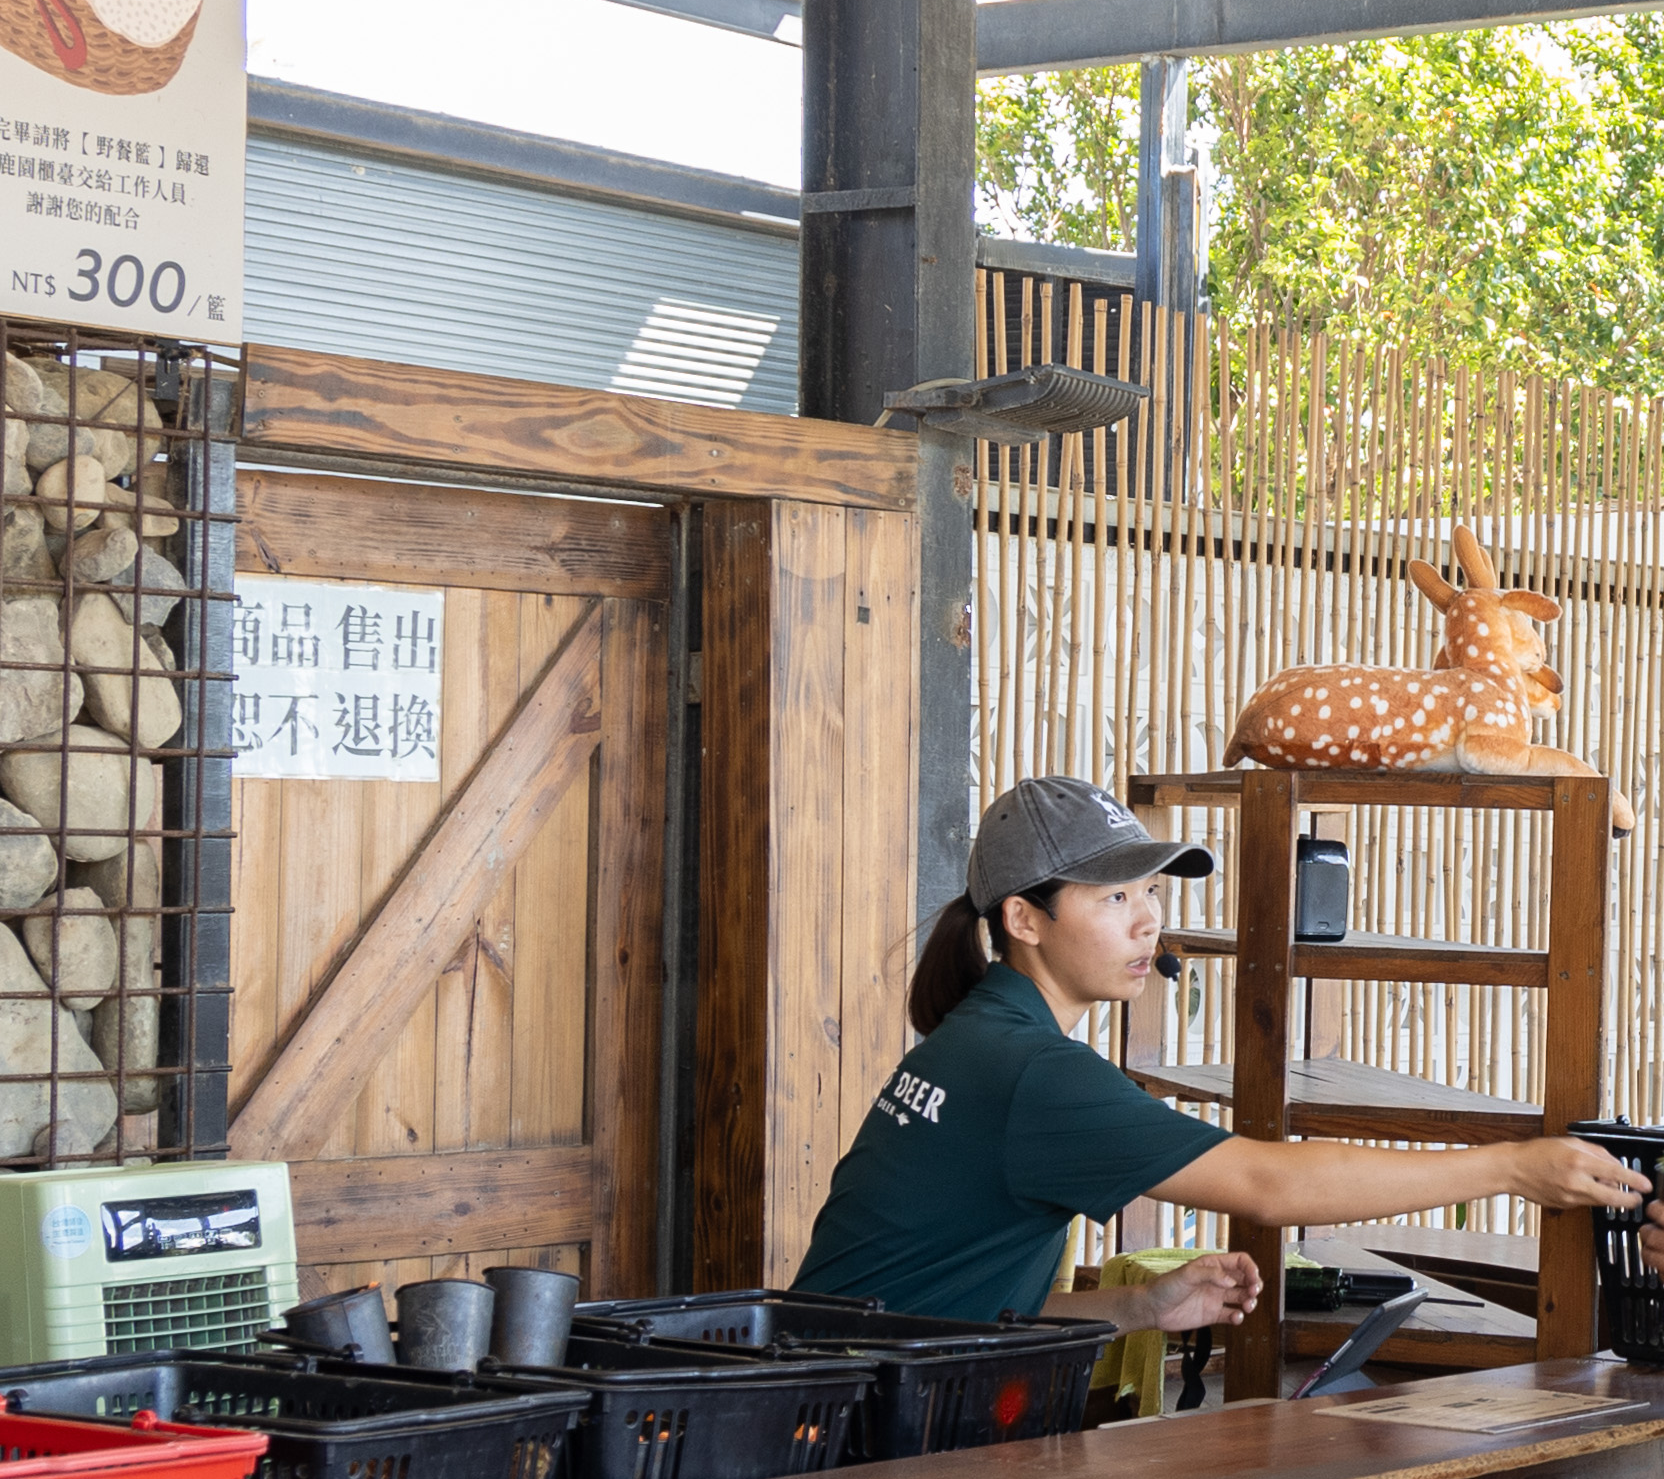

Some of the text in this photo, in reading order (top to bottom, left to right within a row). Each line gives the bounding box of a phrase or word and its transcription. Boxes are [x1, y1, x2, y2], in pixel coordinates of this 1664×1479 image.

[25, 190, 141, 231] 謝謝您的配合
[10, 269, 57, 298] NT$
[893, 1071, 947, 1123] DEER
